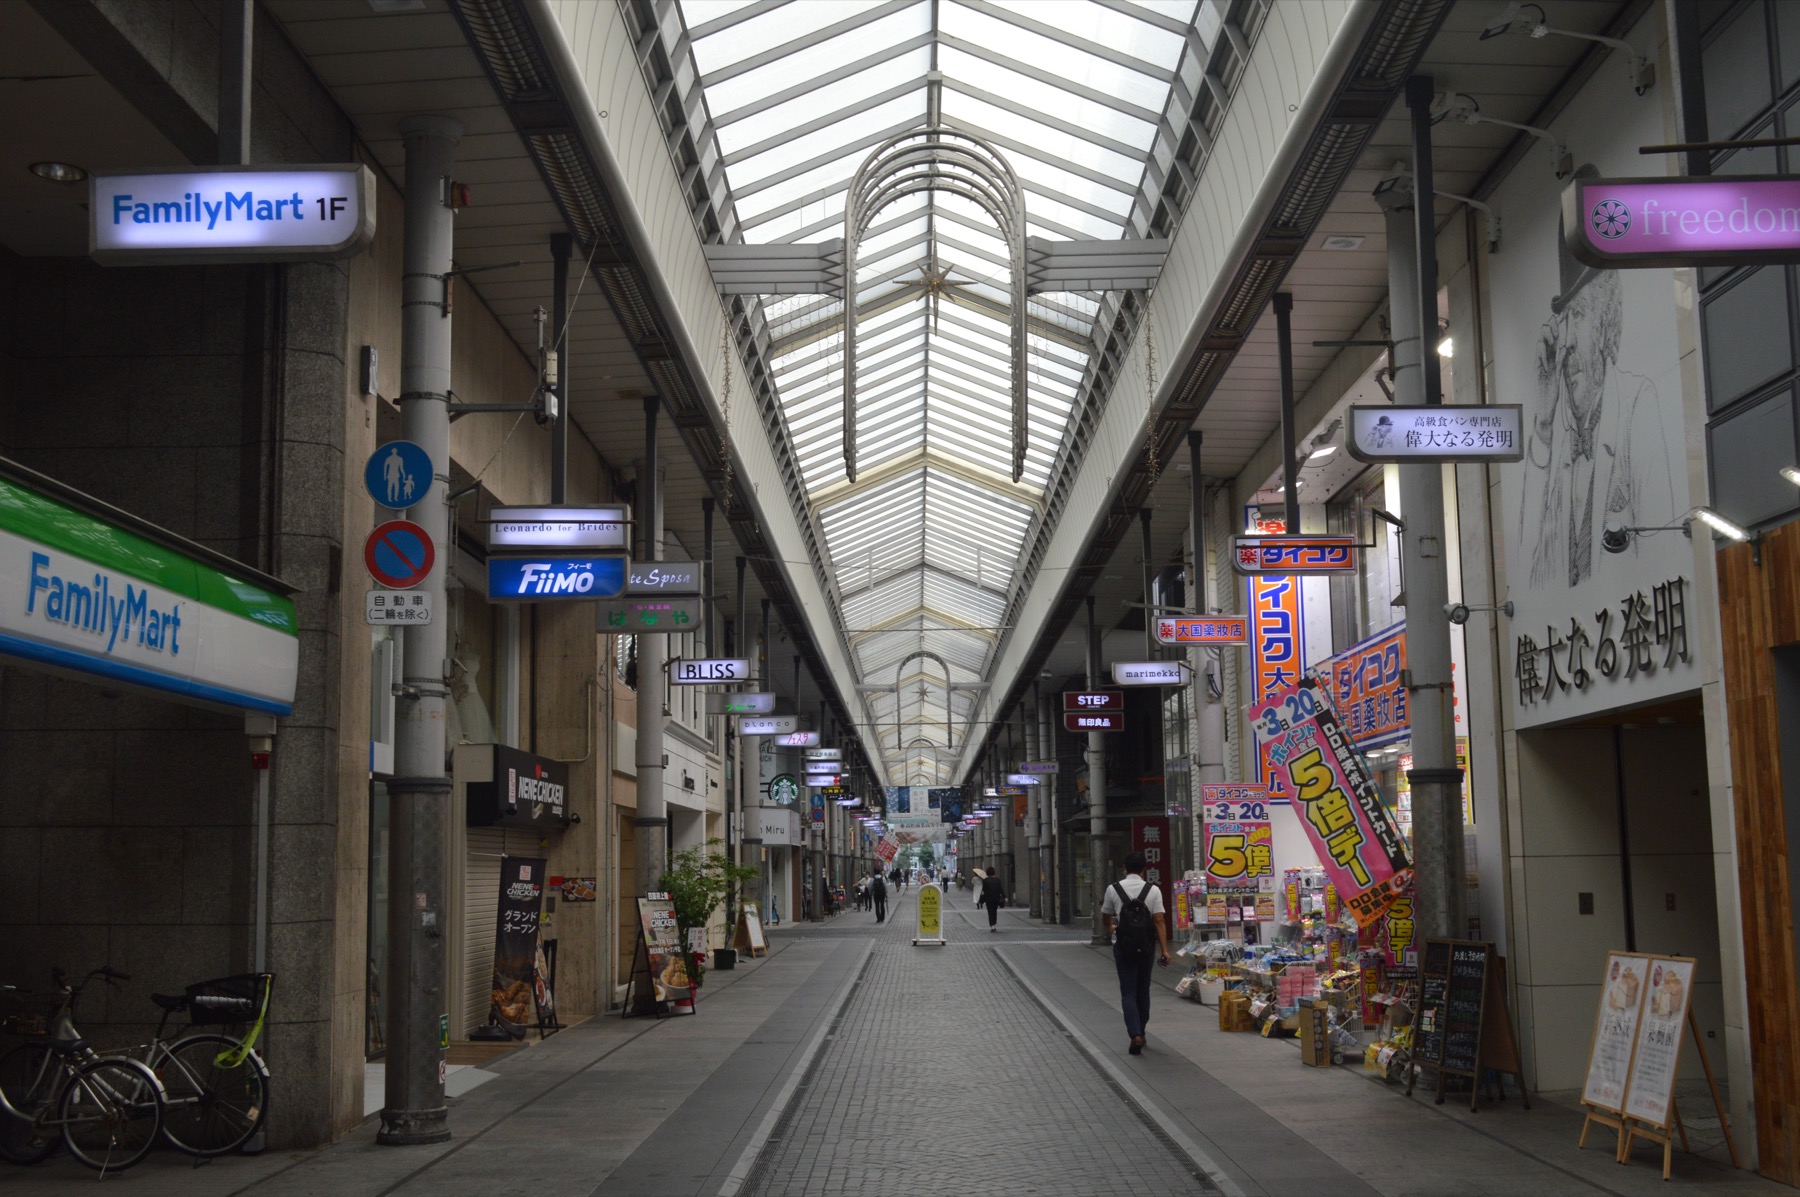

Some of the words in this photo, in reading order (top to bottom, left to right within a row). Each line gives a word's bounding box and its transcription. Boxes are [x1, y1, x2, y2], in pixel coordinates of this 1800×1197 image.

[113, 192, 304, 230] FamilyMart
[316, 197, 348, 221] 1F
[1414, 415, 1503, 428] 高級食パン専門店
[1404, 430, 1513, 449] 偉大なる発明
[495, 521, 553, 533] Leonardo
[558, 524, 573, 532] for
[578, 521, 619, 532] Brides
[1262, 542, 1349, 565] ダイコク
[25, 551, 182, 656] FamilyMart
[374, 595, 424, 607] 自動車
[1515, 575, 1691, 706] 偉大なる発明
[686, 663, 735, 679] BLISS
[1125, 669, 1181, 678] marimekko
[1338, 639, 1401, 703] ダイコク
[1077, 695, 1110, 706] STEP
[1078, 718, 1112, 727] 無印良品
[518, 776, 538, 801] NENE
[537, 780, 564, 806] CHICKEN
[766, 825, 785, 835] Miru
[1209, 823, 1244, 833] ポイント
[1208, 834, 1272, 879] 5倍デー
[511, 882, 534, 890] NENE
[507, 888, 540, 897] CHICKEN
[504, 909, 538, 922] グランド
[653, 911, 669, 919] NENE
[503, 922, 536, 934] オープン
[651, 919, 676, 927] CHICKEN
[1387, 896, 1414, 965] 5倍デー
